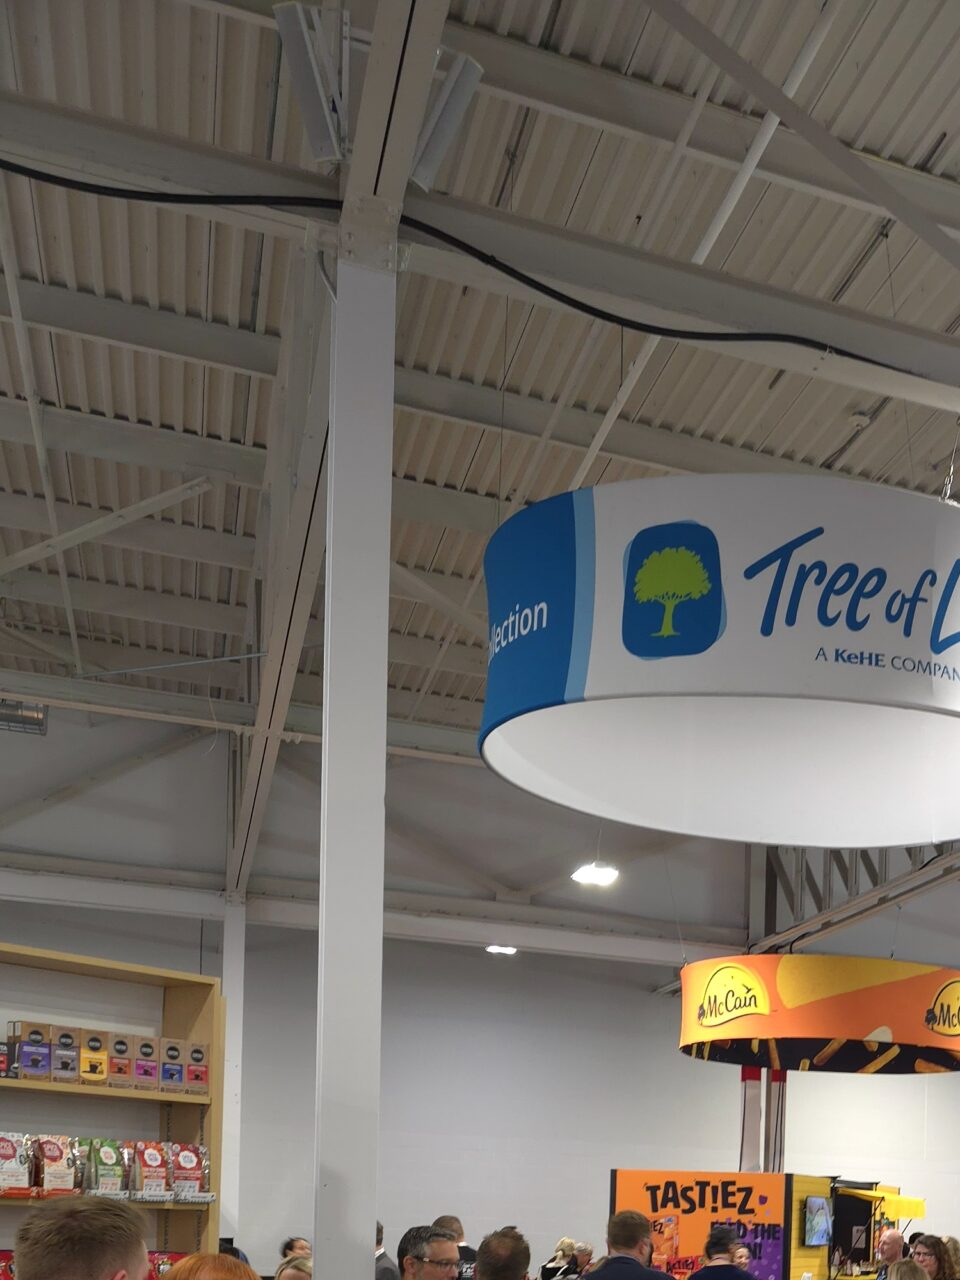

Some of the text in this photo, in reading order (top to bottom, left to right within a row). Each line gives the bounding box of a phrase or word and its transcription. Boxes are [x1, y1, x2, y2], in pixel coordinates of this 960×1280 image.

[743, 526, 888, 638] Tree
[885, 571, 938, 639] of
[814, 647, 828, 662] A
[834, 648, 886, 669] KeHE
[705, 987, 758, 1019] McCain
